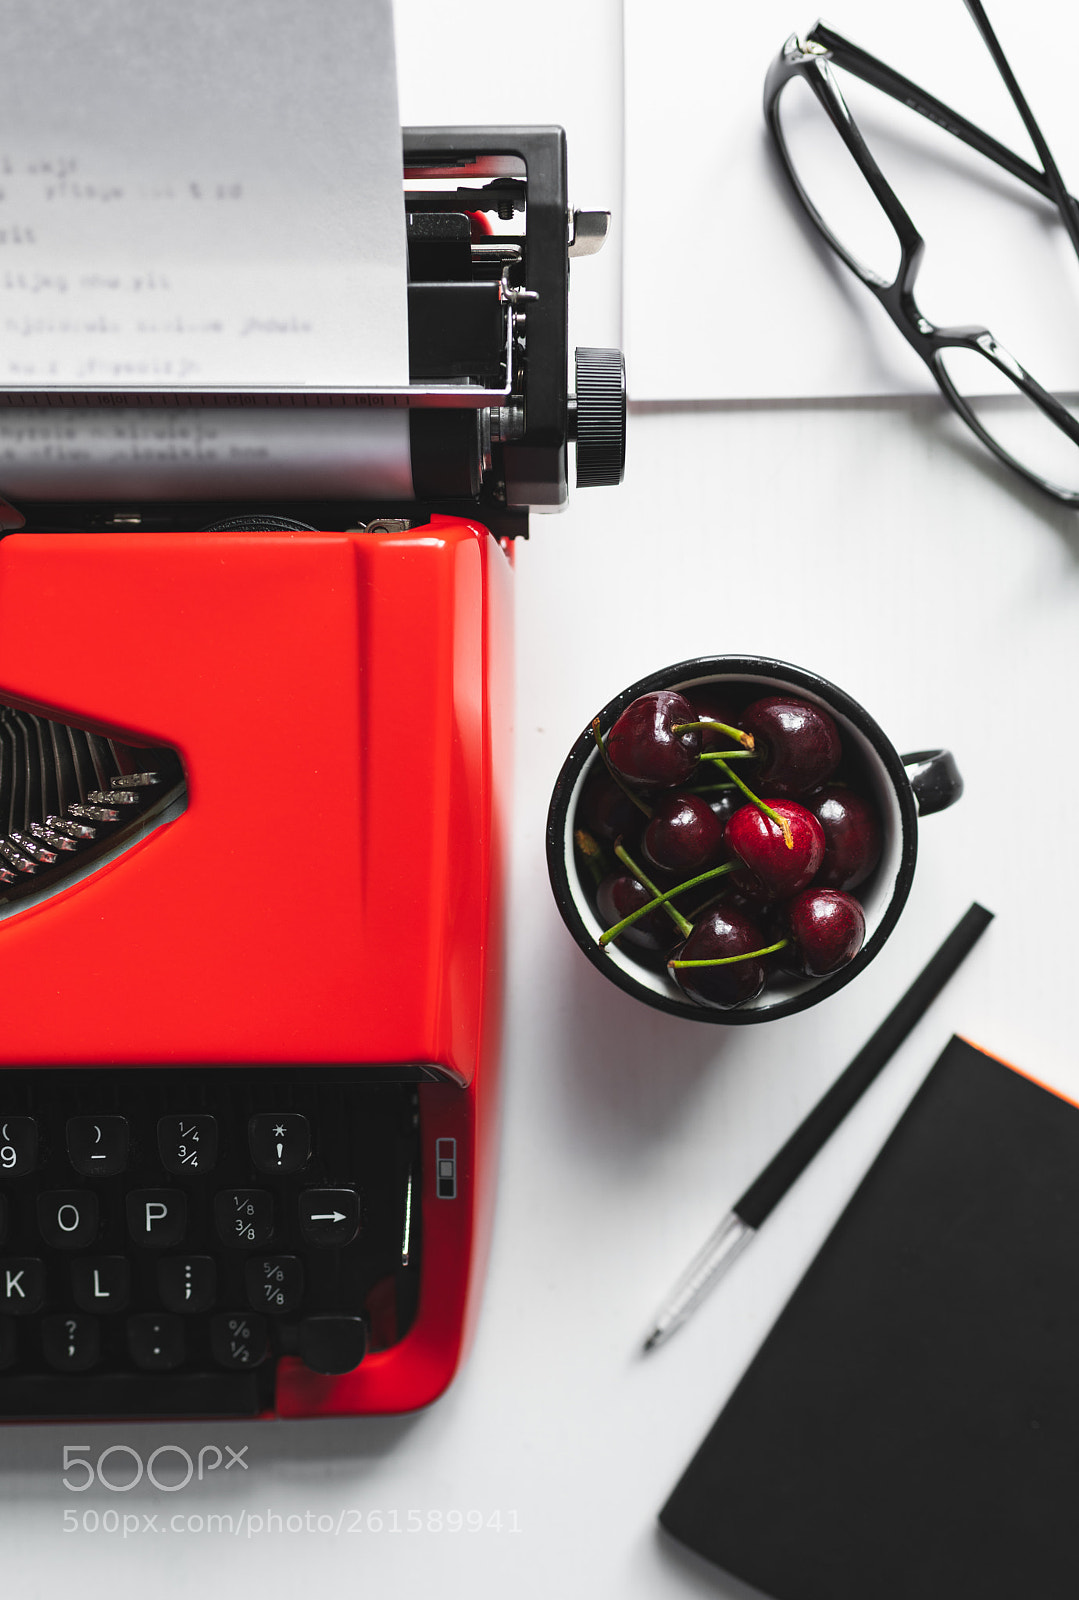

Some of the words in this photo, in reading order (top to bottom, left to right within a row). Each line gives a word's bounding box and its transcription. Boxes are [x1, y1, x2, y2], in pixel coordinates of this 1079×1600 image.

[0, 1145, 17, 1169] 9
[276, 1142, 284, 1166] !
[145, 1202, 168, 1232] P
[6, 1270, 26, 1298] K
[93, 1269, 110, 1298] L
